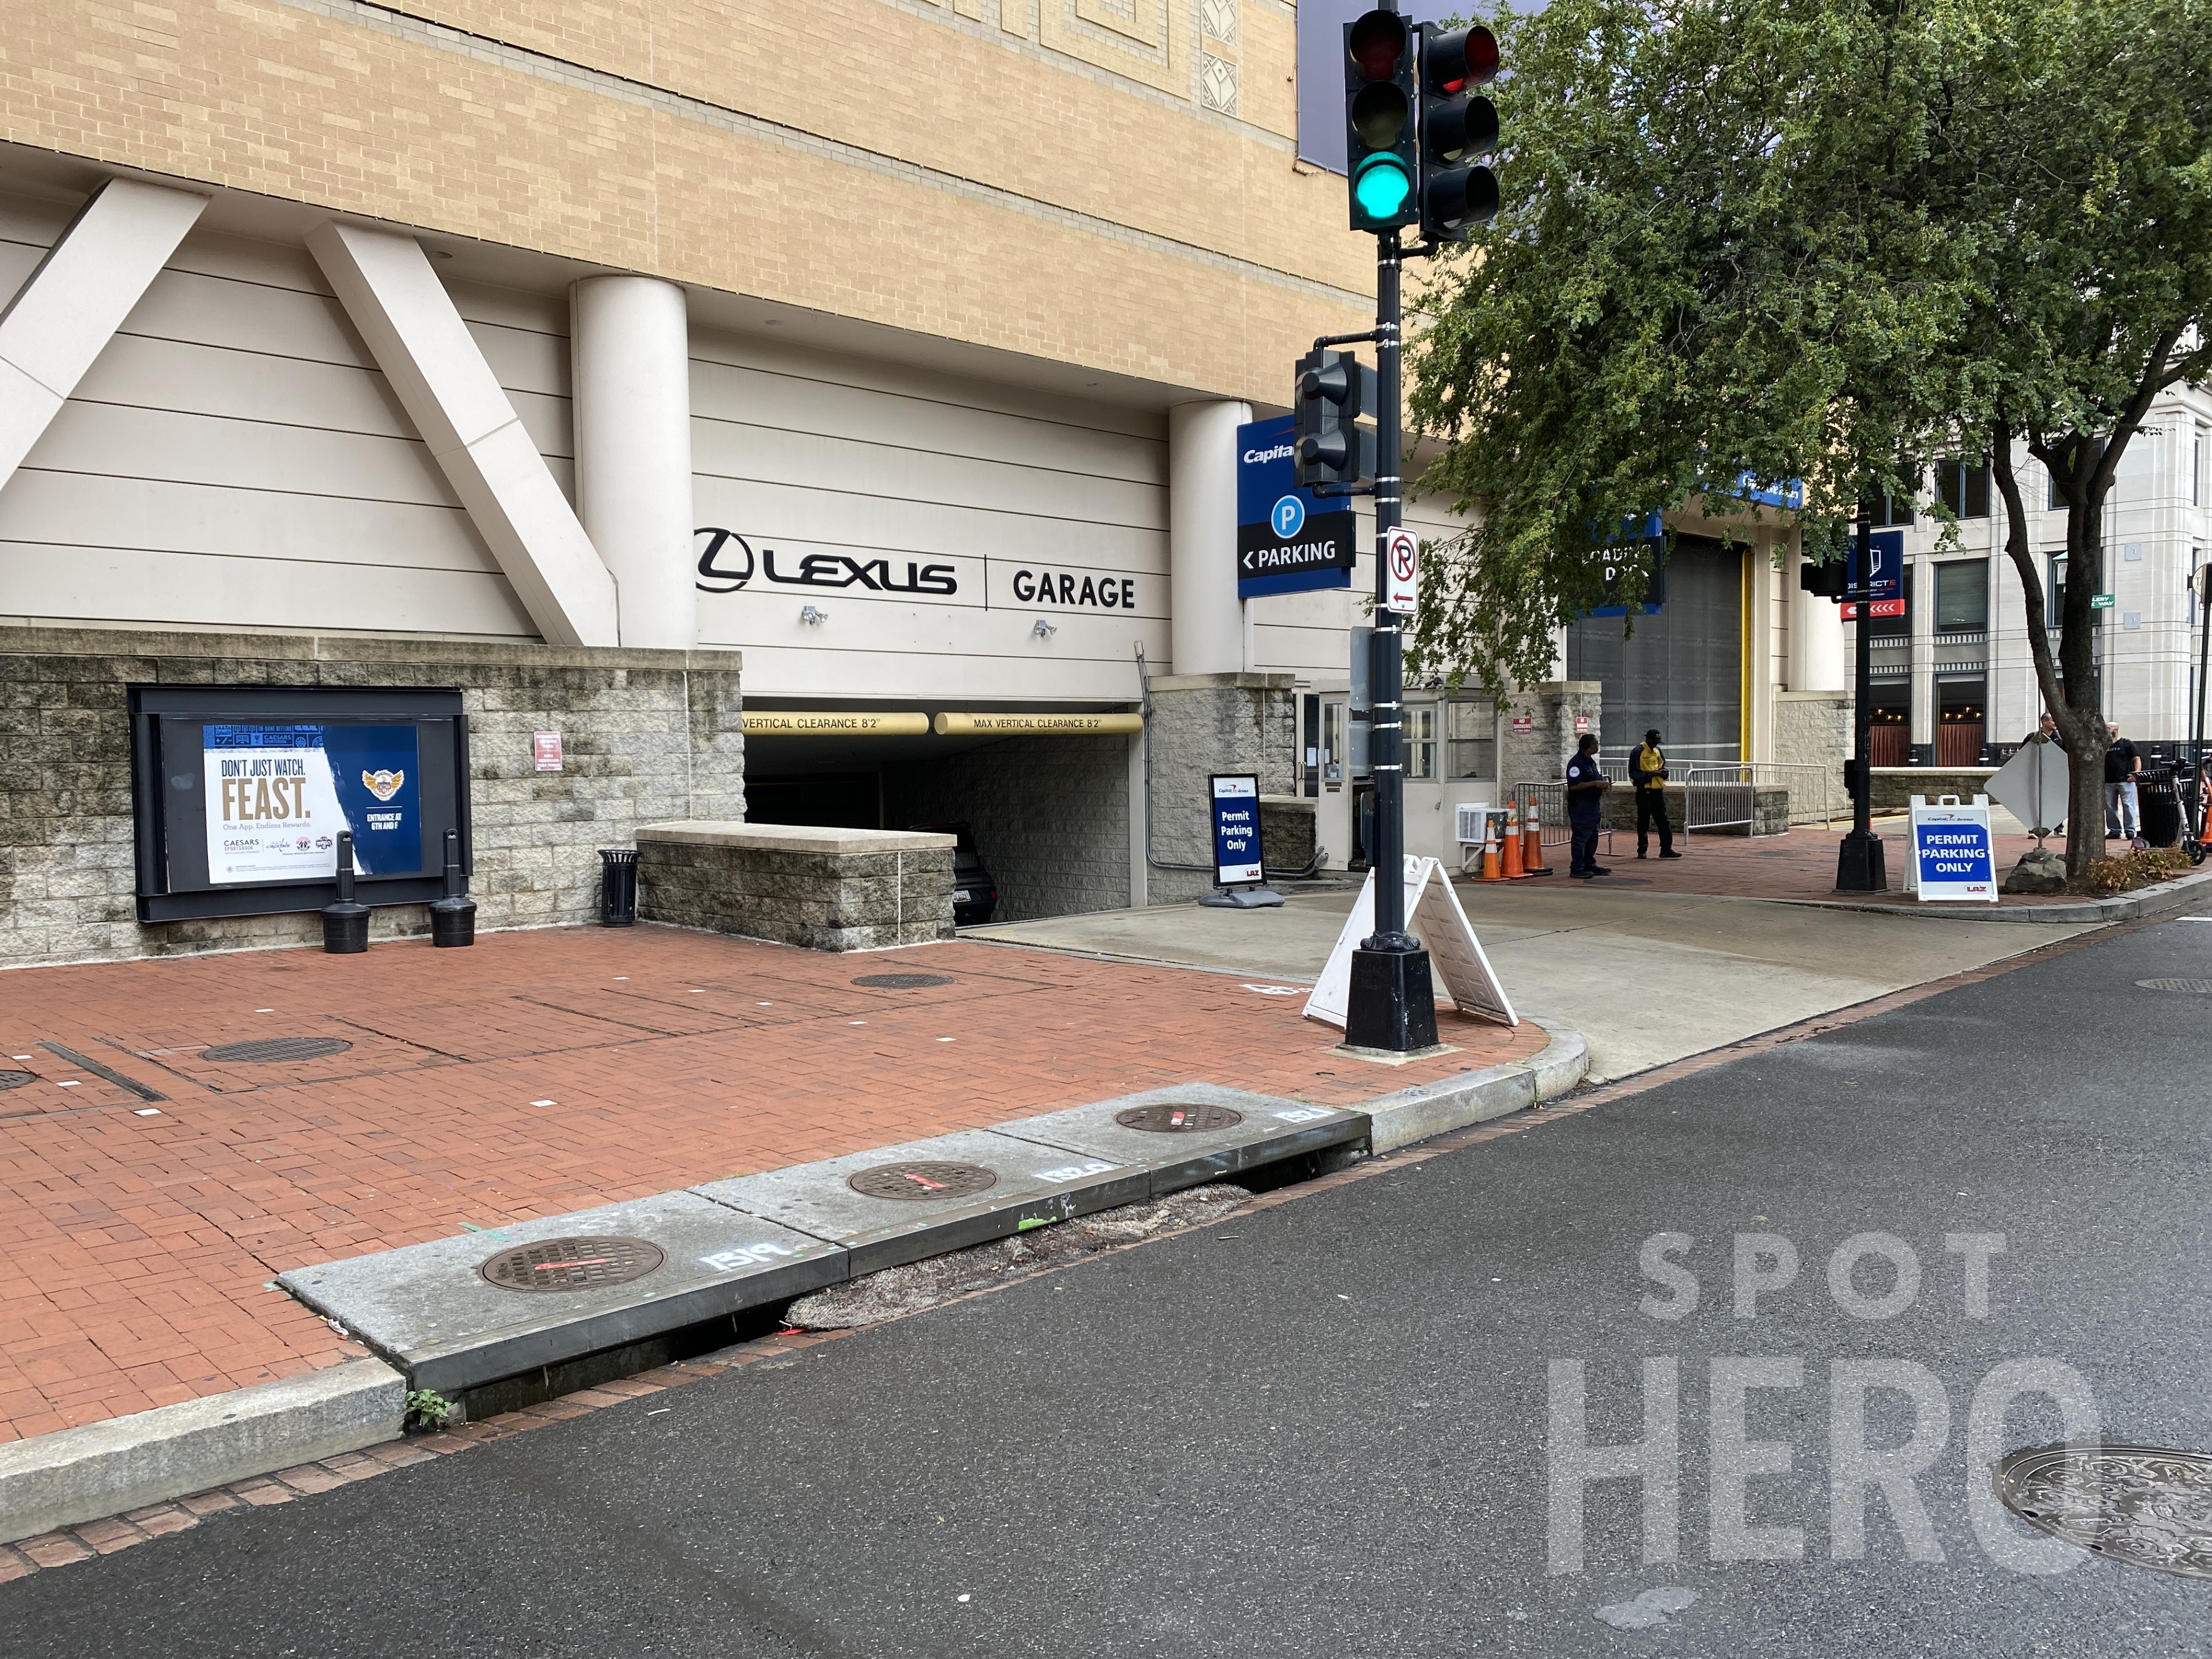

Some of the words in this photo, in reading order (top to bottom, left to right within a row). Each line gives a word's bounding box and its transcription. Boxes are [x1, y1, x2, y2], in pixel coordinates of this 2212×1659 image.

[1282, 505, 1296, 531] P
[1258, 540, 1335, 568] PARKING
[763, 550, 957, 595] LEXUS
[1013, 570, 1135, 609] GARAGE
[1847, 580, 1889, 589] DISRICT
[743, 719, 793, 728] VERTICAL
[797, 718, 858, 728] CLEARANCE
[974, 719, 993, 728] MAX
[995, 719, 1035, 728] VERTICAL
[1037, 719, 1084, 728] CLEARANCE
[221, 759, 247, 777] DON'T
[250, 759, 272, 777] JUST
[274, 759, 306, 776] WATCH.
[222, 777, 310, 821] FEAST.
[367, 813, 395, 822] ENTRANCE
[1222, 810, 1249, 821] Permit
[371, 822, 382, 830] 6TH
[1221, 825, 1252, 836] Parking
[224, 839, 259, 847] CAESARS
[1227, 839, 1246, 851] Only
[1926, 835, 1979, 844] PERMIT
[1922, 849, 1986, 858] PARKING
[1936, 863, 1974, 872] ONLY
[1032, 1164, 1113, 1183] 1320
[698, 1243, 793, 1271] 1319
